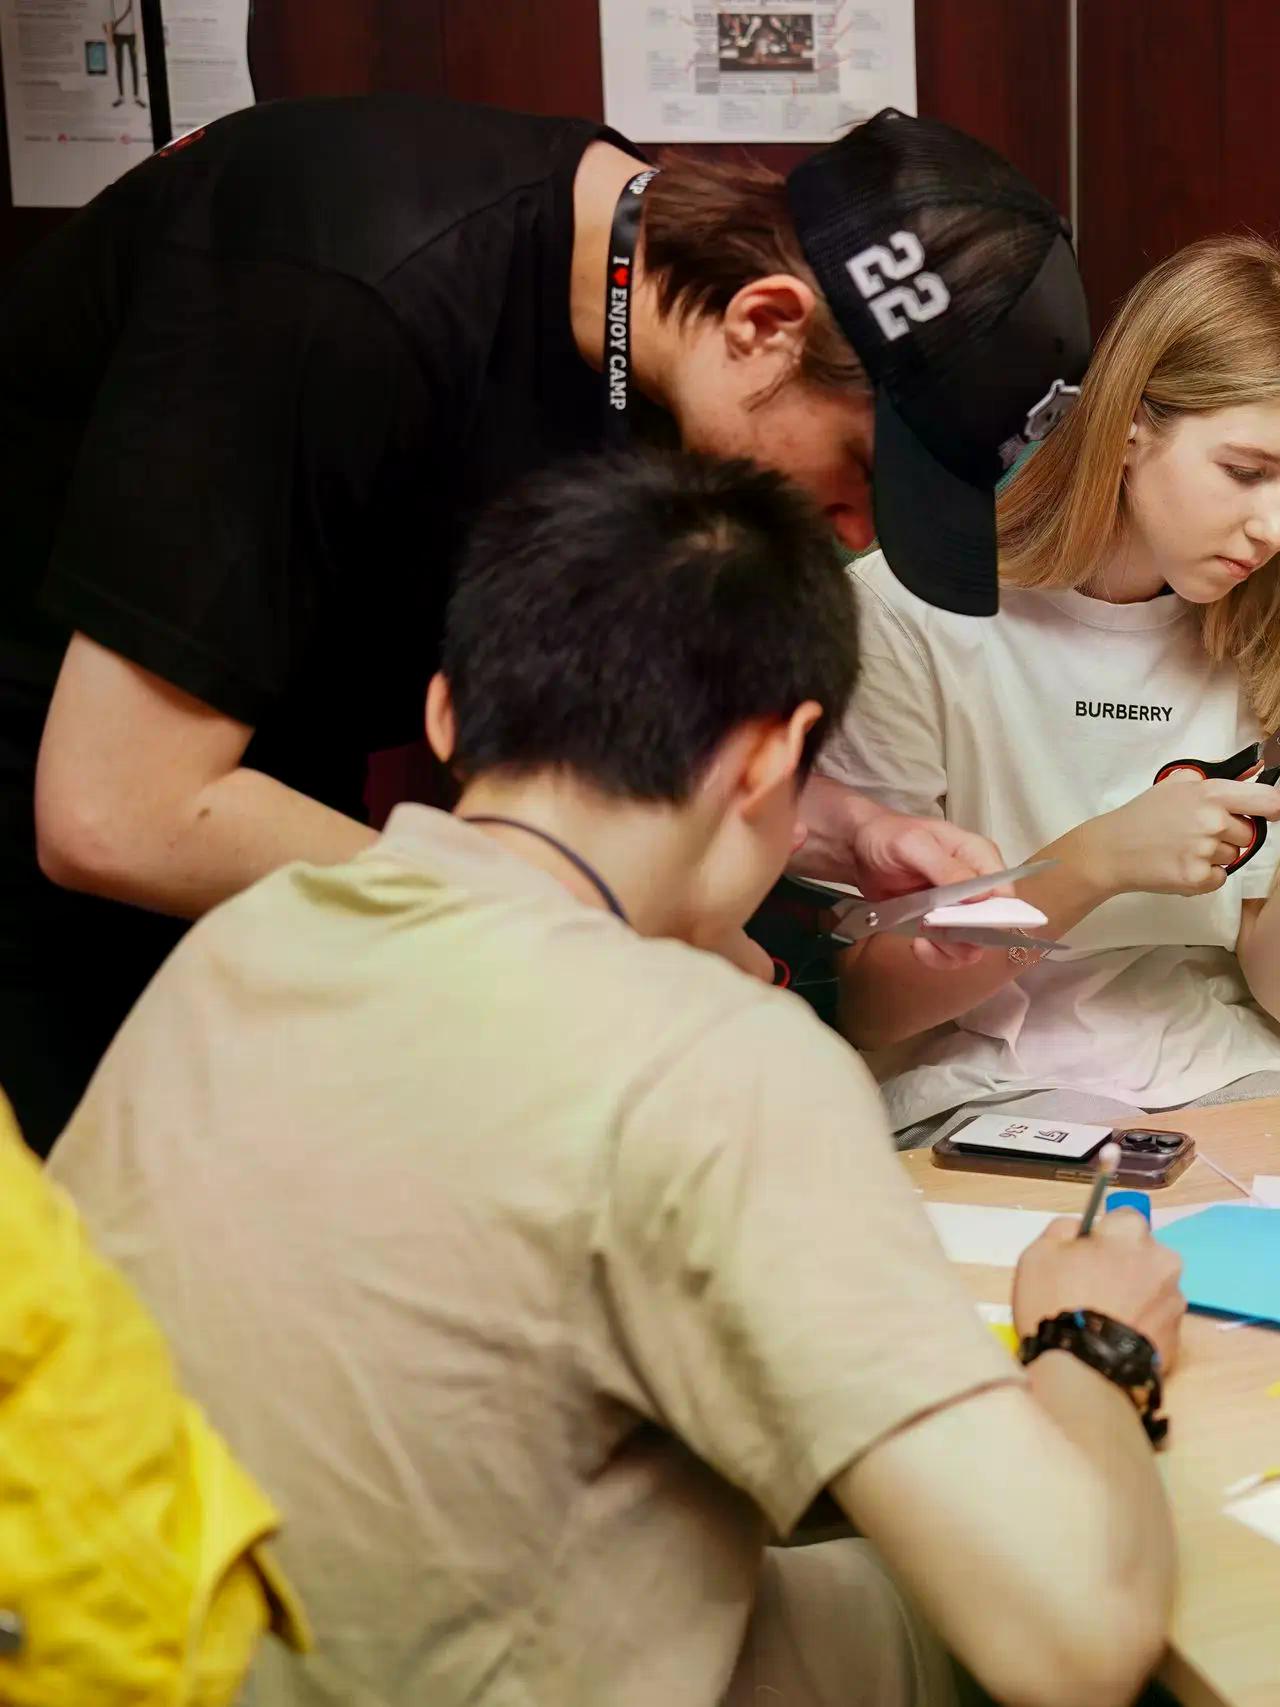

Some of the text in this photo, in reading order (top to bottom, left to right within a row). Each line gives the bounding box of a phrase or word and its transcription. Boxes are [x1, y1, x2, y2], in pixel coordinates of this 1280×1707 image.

[608, 256, 630, 411] I ENJOY CAMP
[846, 230, 951, 341] 22
[1074, 700, 1173, 722] BURBERRY
